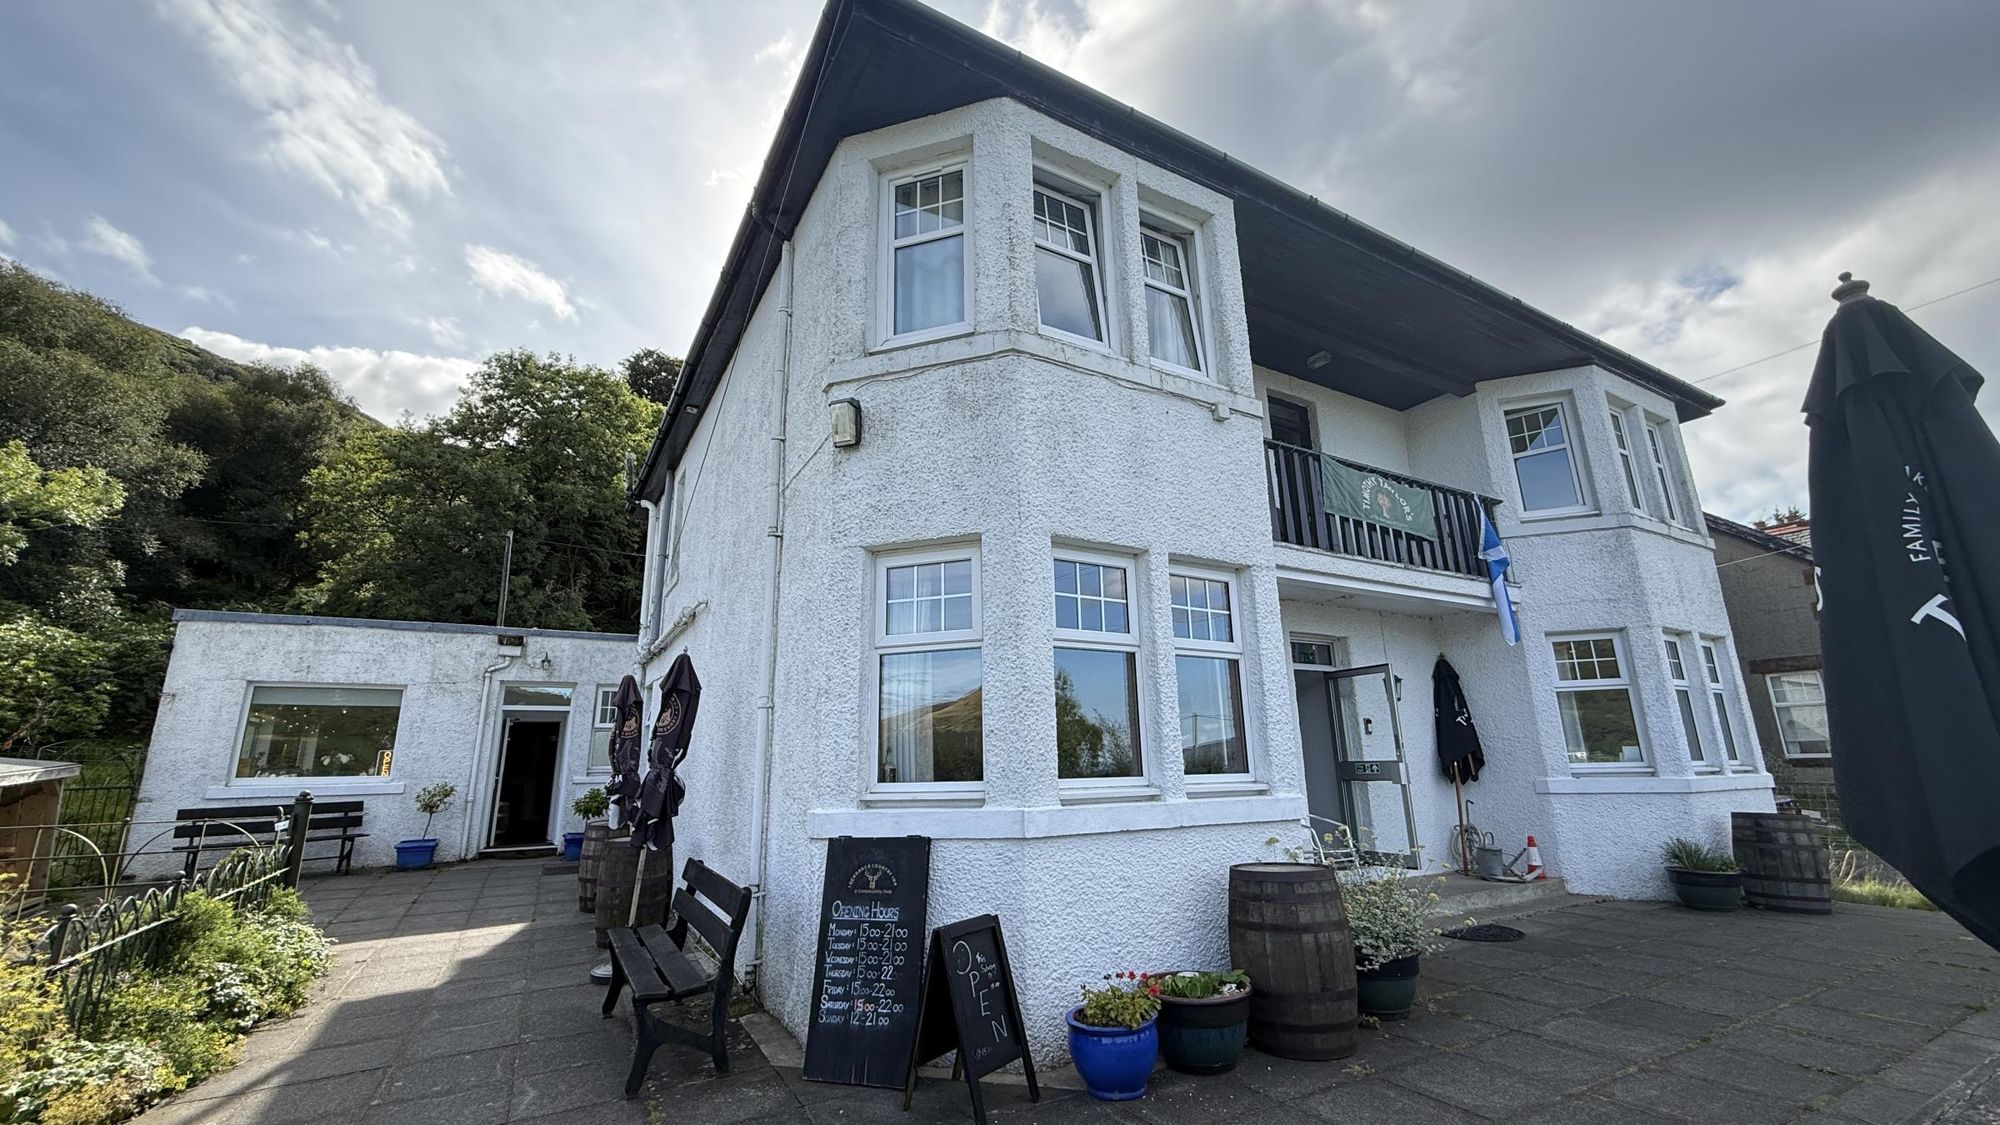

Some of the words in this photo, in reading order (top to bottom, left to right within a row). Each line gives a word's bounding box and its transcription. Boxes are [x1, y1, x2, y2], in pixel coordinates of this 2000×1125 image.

[1361, 476, 1378, 510] TIMOTHY
[1901, 491, 1932, 562] FAMILY
[381, 751, 392, 777] OPEN
